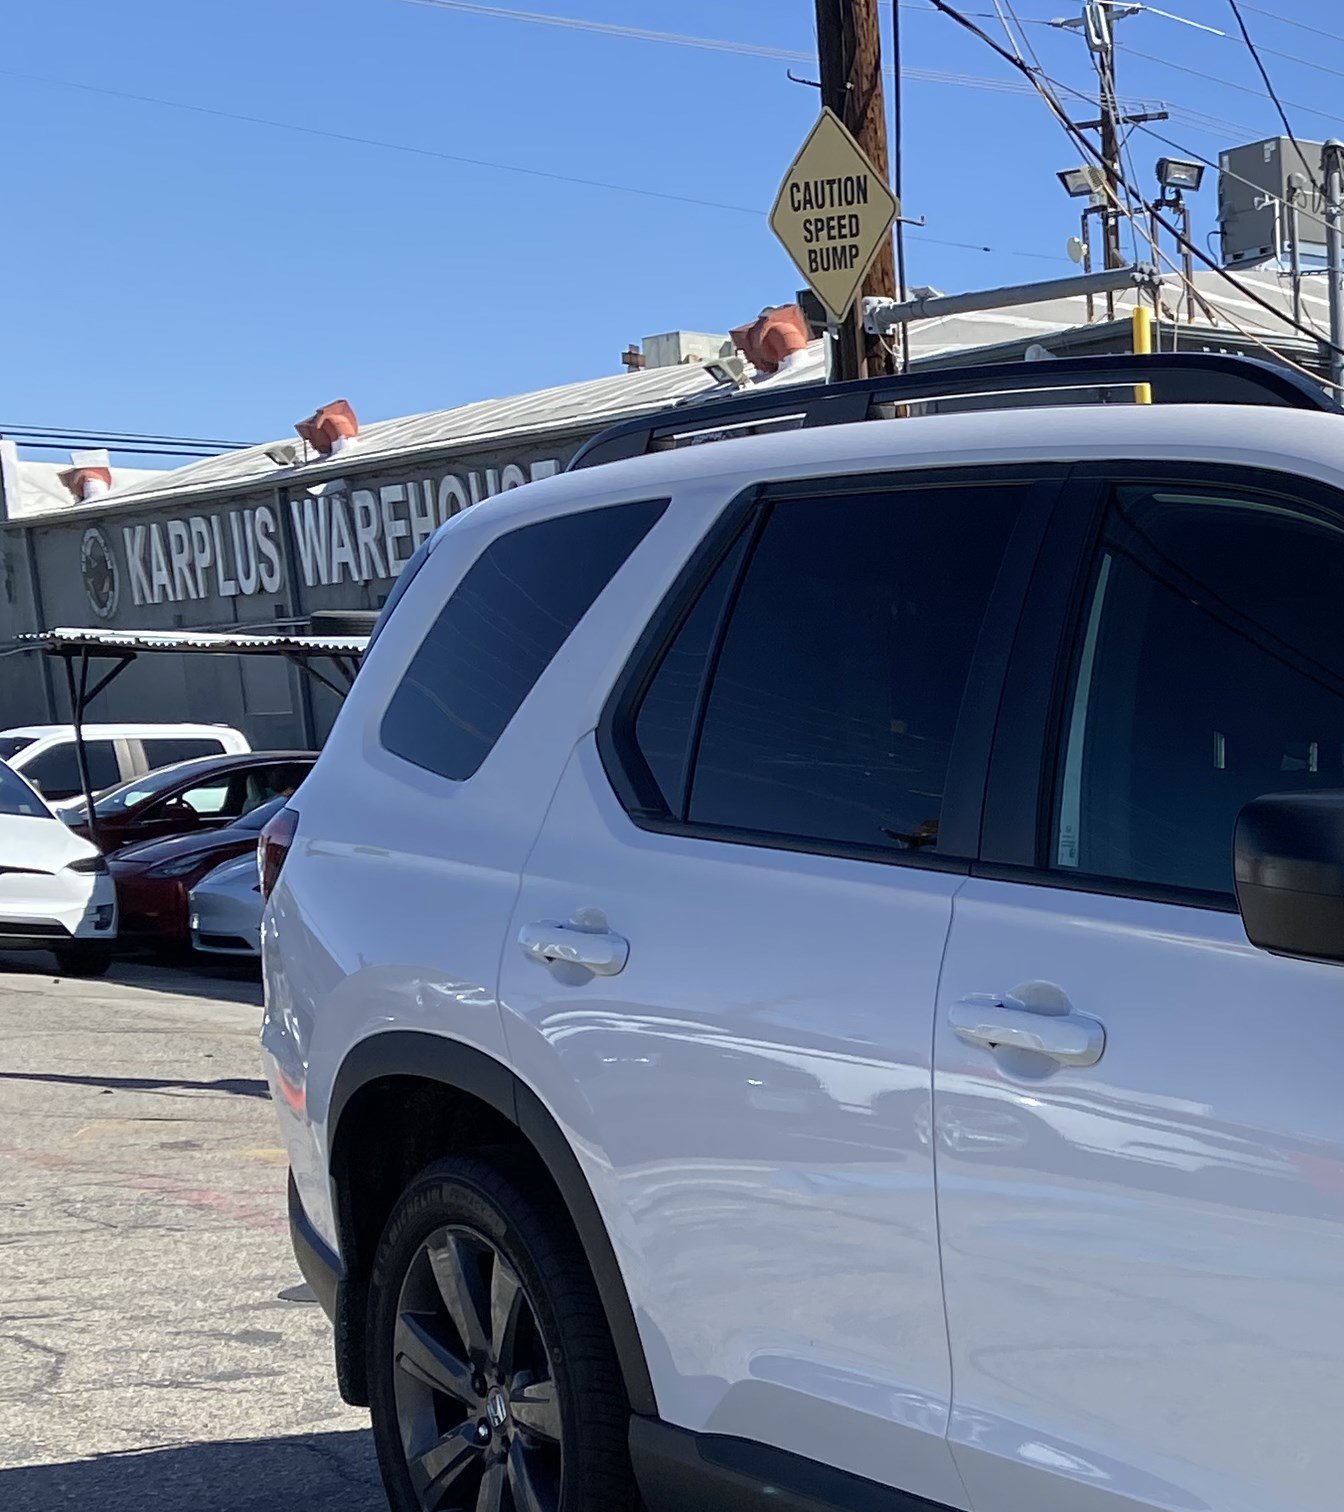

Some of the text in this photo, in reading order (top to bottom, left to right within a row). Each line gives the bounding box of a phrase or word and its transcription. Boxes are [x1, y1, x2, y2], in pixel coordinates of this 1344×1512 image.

[790, 174, 868, 212] CAUTION
[803, 214, 860, 243] SPEED
[808, 244, 860, 273] BUMP
[122, 459, 560, 605] KARPLUS WAREH
